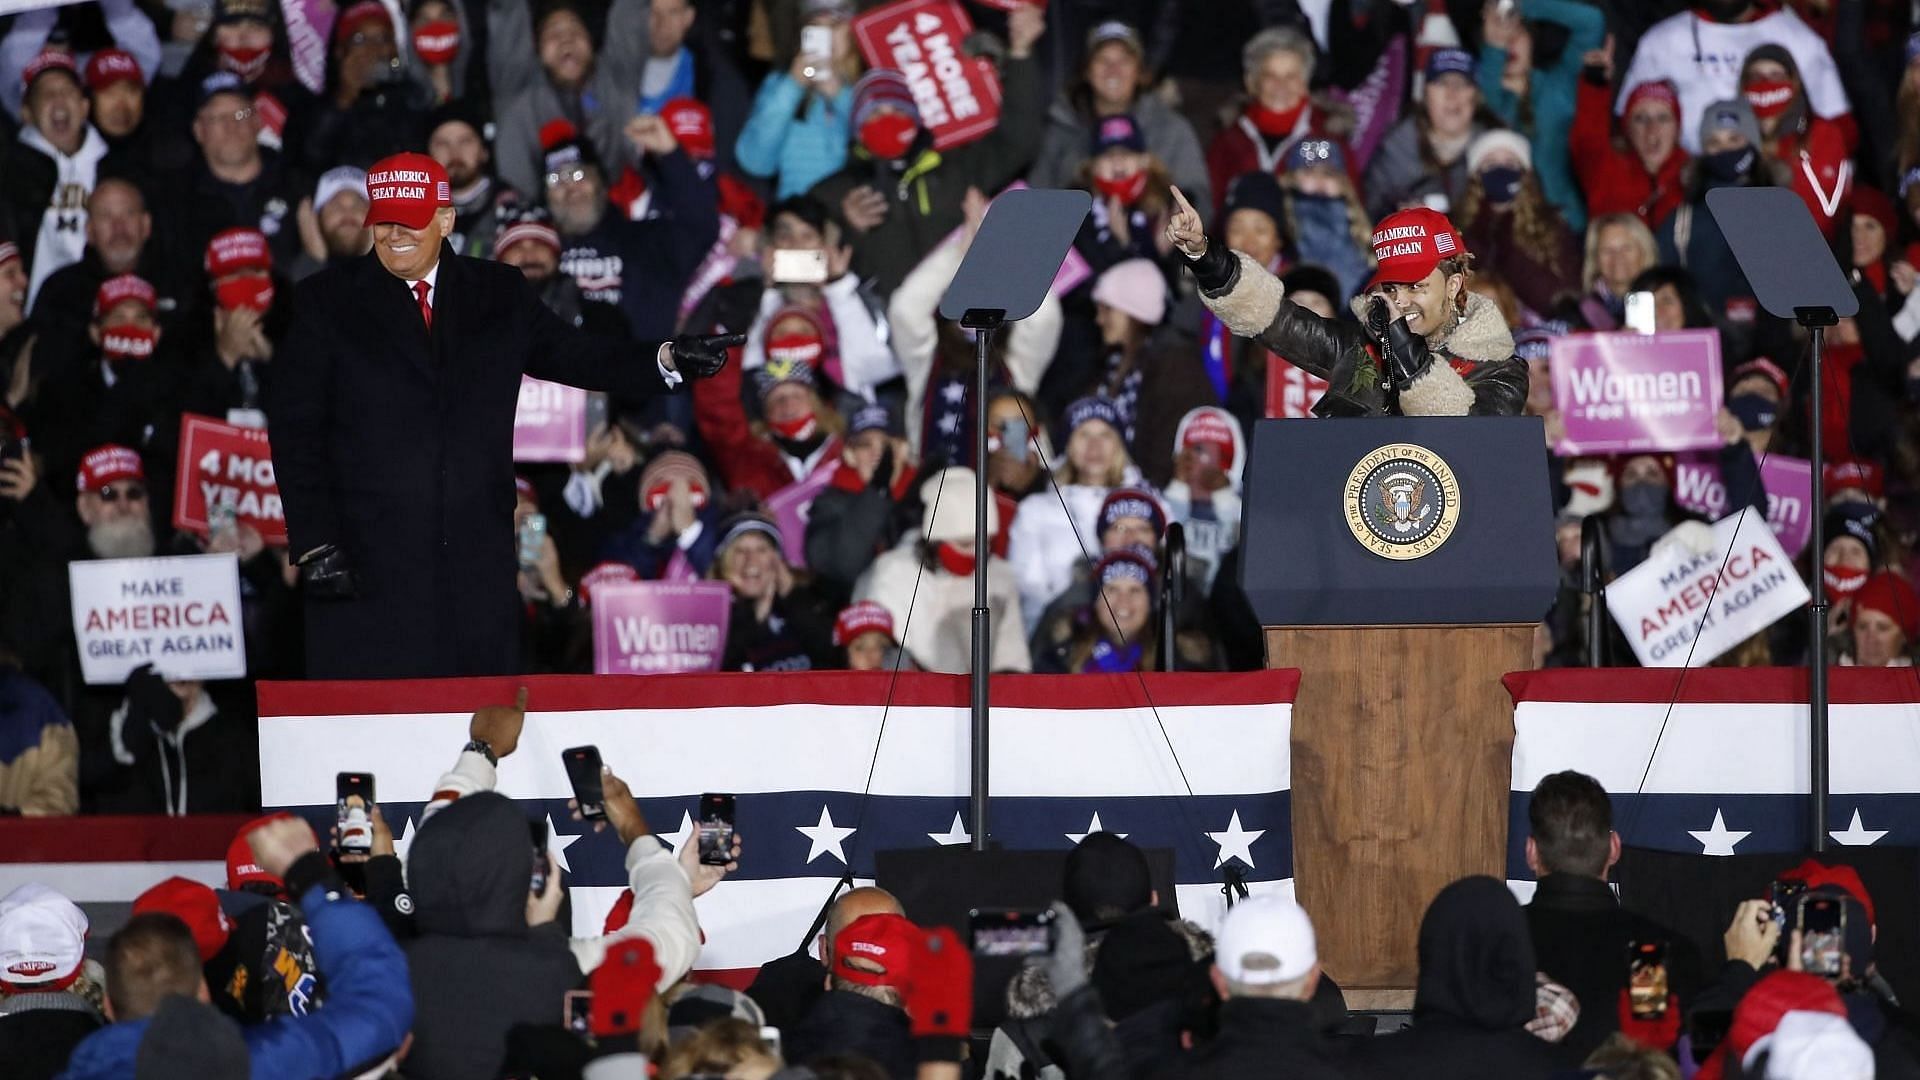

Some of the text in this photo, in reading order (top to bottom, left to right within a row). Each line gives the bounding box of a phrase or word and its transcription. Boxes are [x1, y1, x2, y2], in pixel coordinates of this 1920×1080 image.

[914, 11, 980, 121] 4 MORE
[368, 170, 431, 185] MAKE AMERICA
[372, 187, 426, 200] GREAT AGAIN
[1384, 226, 1426, 241] AMERICA
[1393, 242, 1422, 256] AGAIN
[1569, 366, 1701, 405] Women
[199, 449, 275, 487] 4 MO
[200, 480, 285, 520] YEAR
[1348, 448, 1457, 554] SEAL OF THE PRESIDENT OF THE UNITED STATES
[120, 577, 185, 597] MAKE
[1640, 546, 1773, 641] AMERICA
[85, 602, 229, 633] AMERICA
[1651, 568, 1787, 660] GREAT AGAIN
[87, 634, 234, 659] GREAT AGAIN
[613, 616, 719, 655] Women
[851, 941, 887, 955] TRUMP
